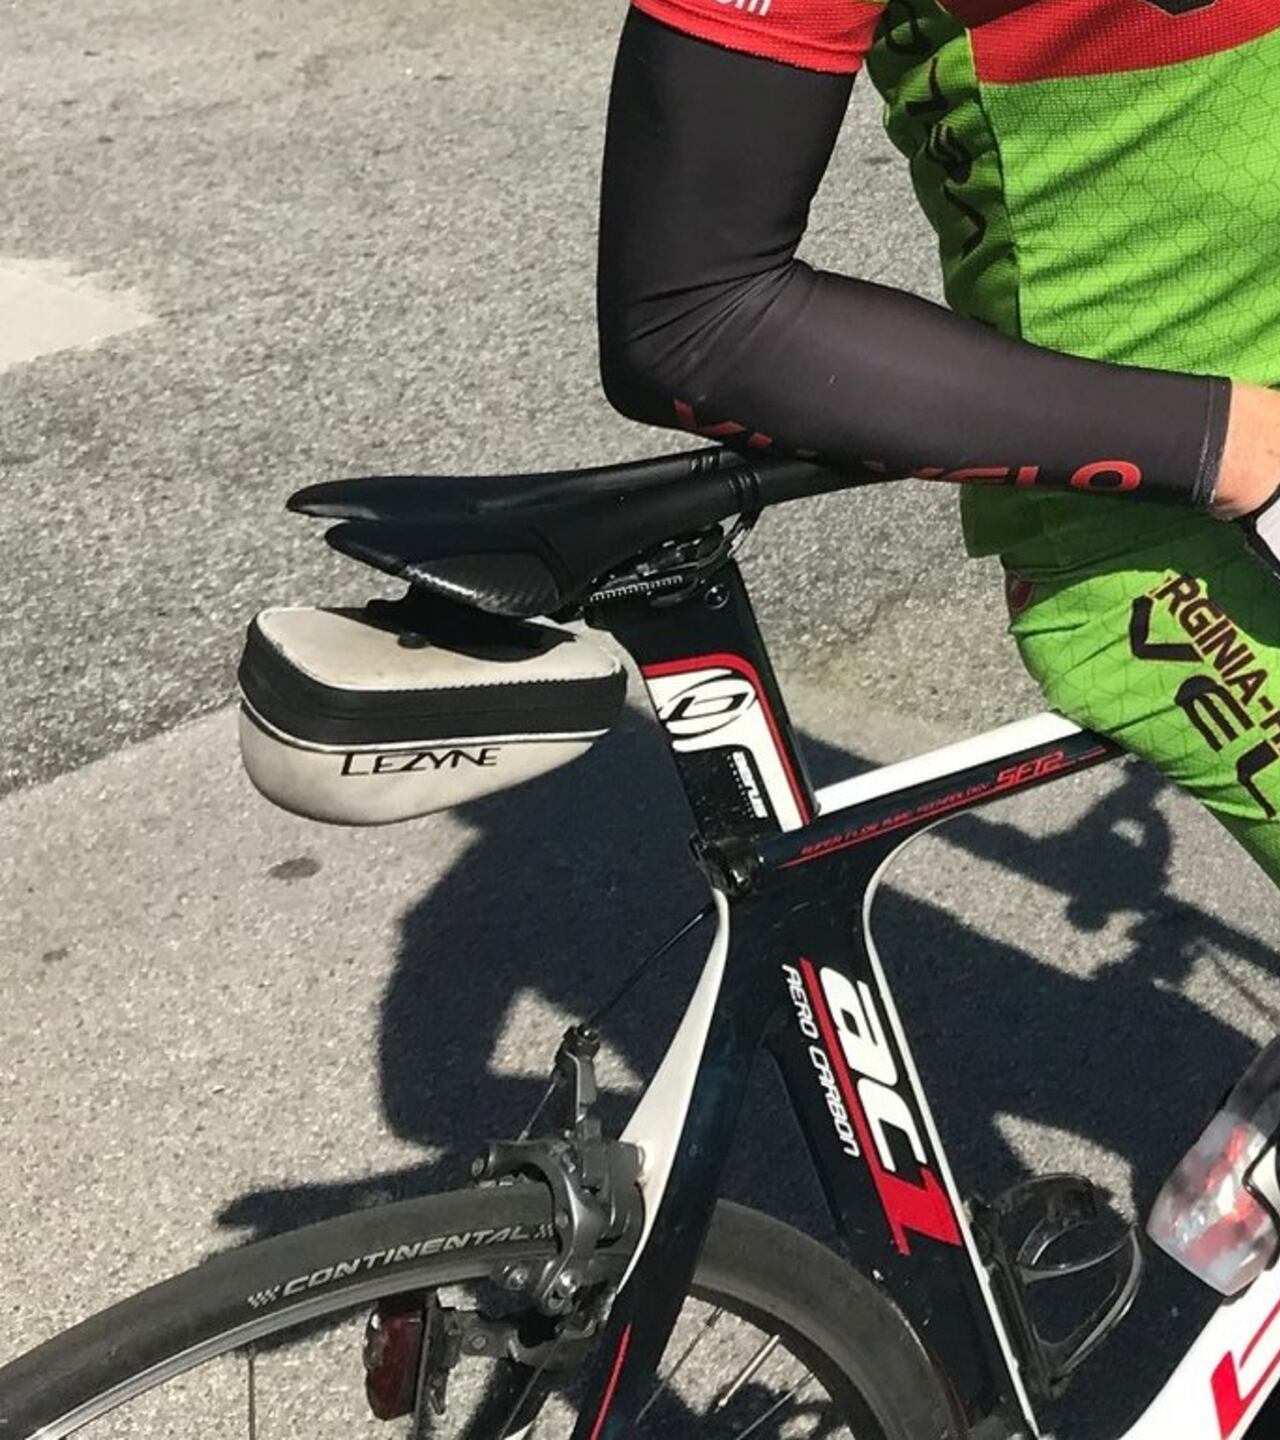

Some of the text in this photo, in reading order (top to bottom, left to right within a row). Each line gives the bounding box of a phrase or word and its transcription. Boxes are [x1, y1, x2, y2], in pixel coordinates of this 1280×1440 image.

[340, 747, 501, 777] LEZYNE
[782, 963, 861, 1158] AERO CARBON
[282, 1225, 530, 1297] CONTINENTAL
